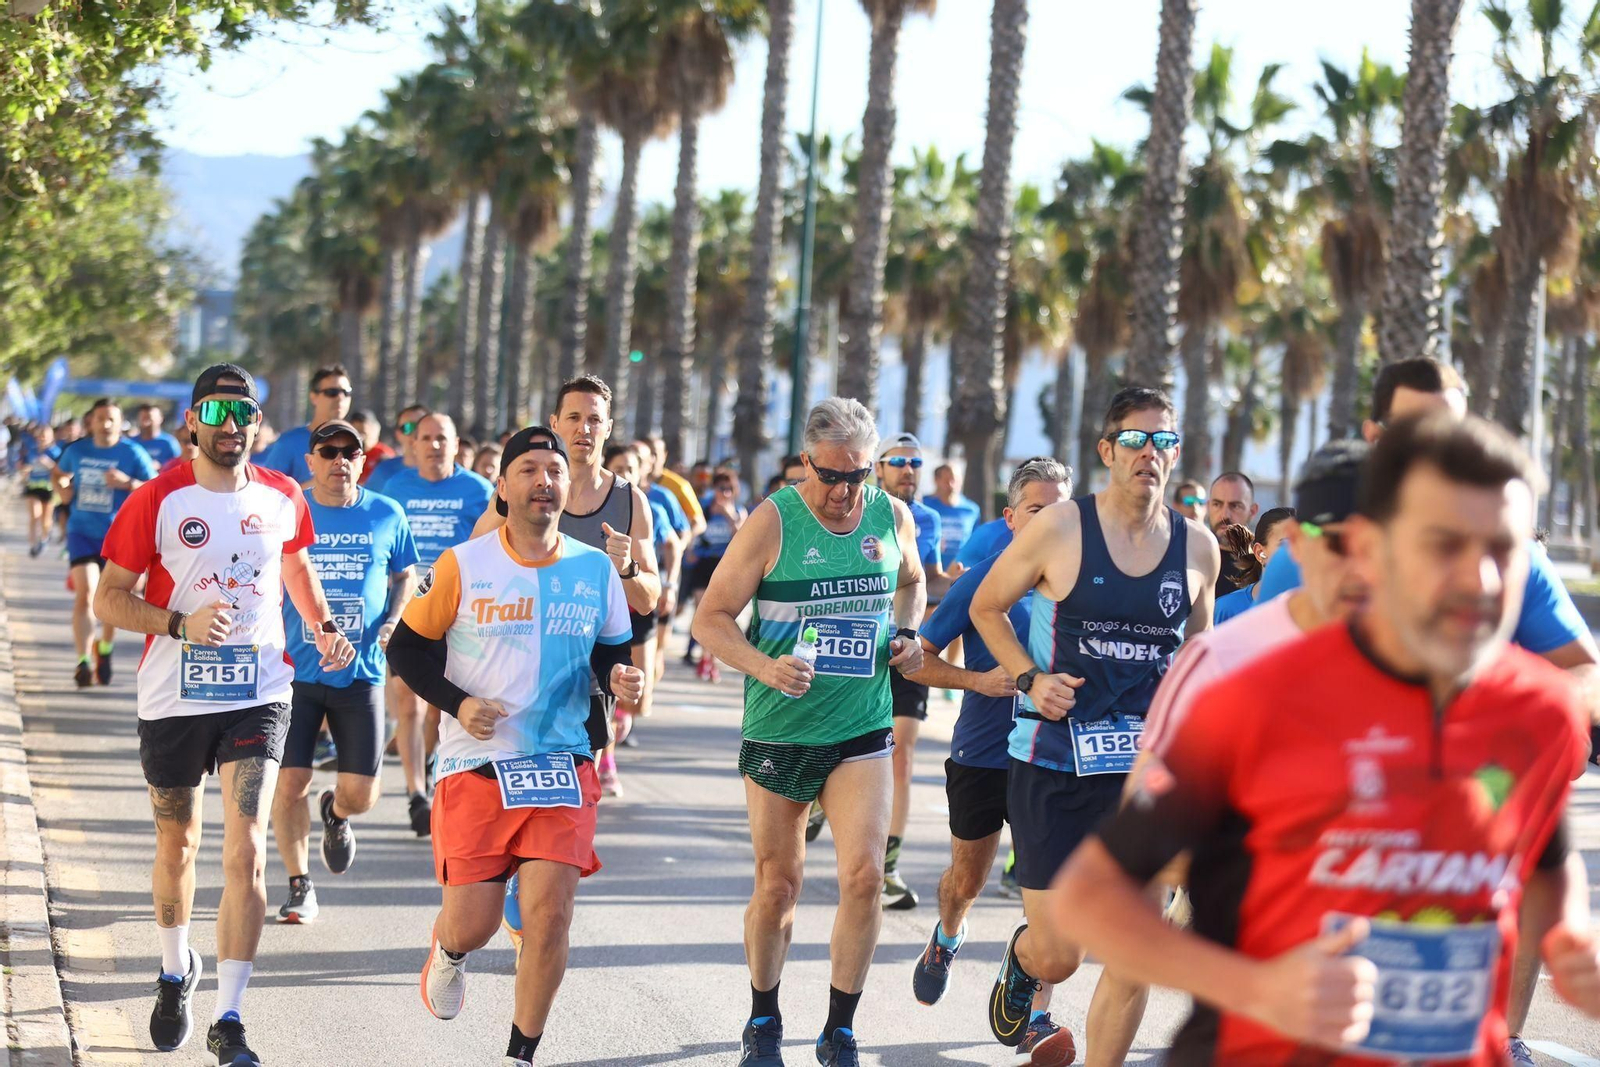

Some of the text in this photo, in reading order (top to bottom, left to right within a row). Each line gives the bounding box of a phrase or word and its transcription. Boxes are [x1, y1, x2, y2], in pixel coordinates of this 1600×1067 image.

[406, 498, 463, 512] mayoral
[319, 572, 364, 580] RIENDS
[810, 576, 889, 597] ATLETISMO
[470, 597, 535, 624] Trail
[545, 602, 600, 623] MONTE
[335, 616, 357, 629] 67
[513, 624, 534, 636] 2022
[1081, 620, 1175, 636] TOD@S A CORRER
[814, 637, 868, 657] 2160
[189, 665, 249, 682] 2151
[509, 759, 533, 767] Carrera
[509, 771, 571, 788] 2150
[1382, 977, 1475, 1012] 682
